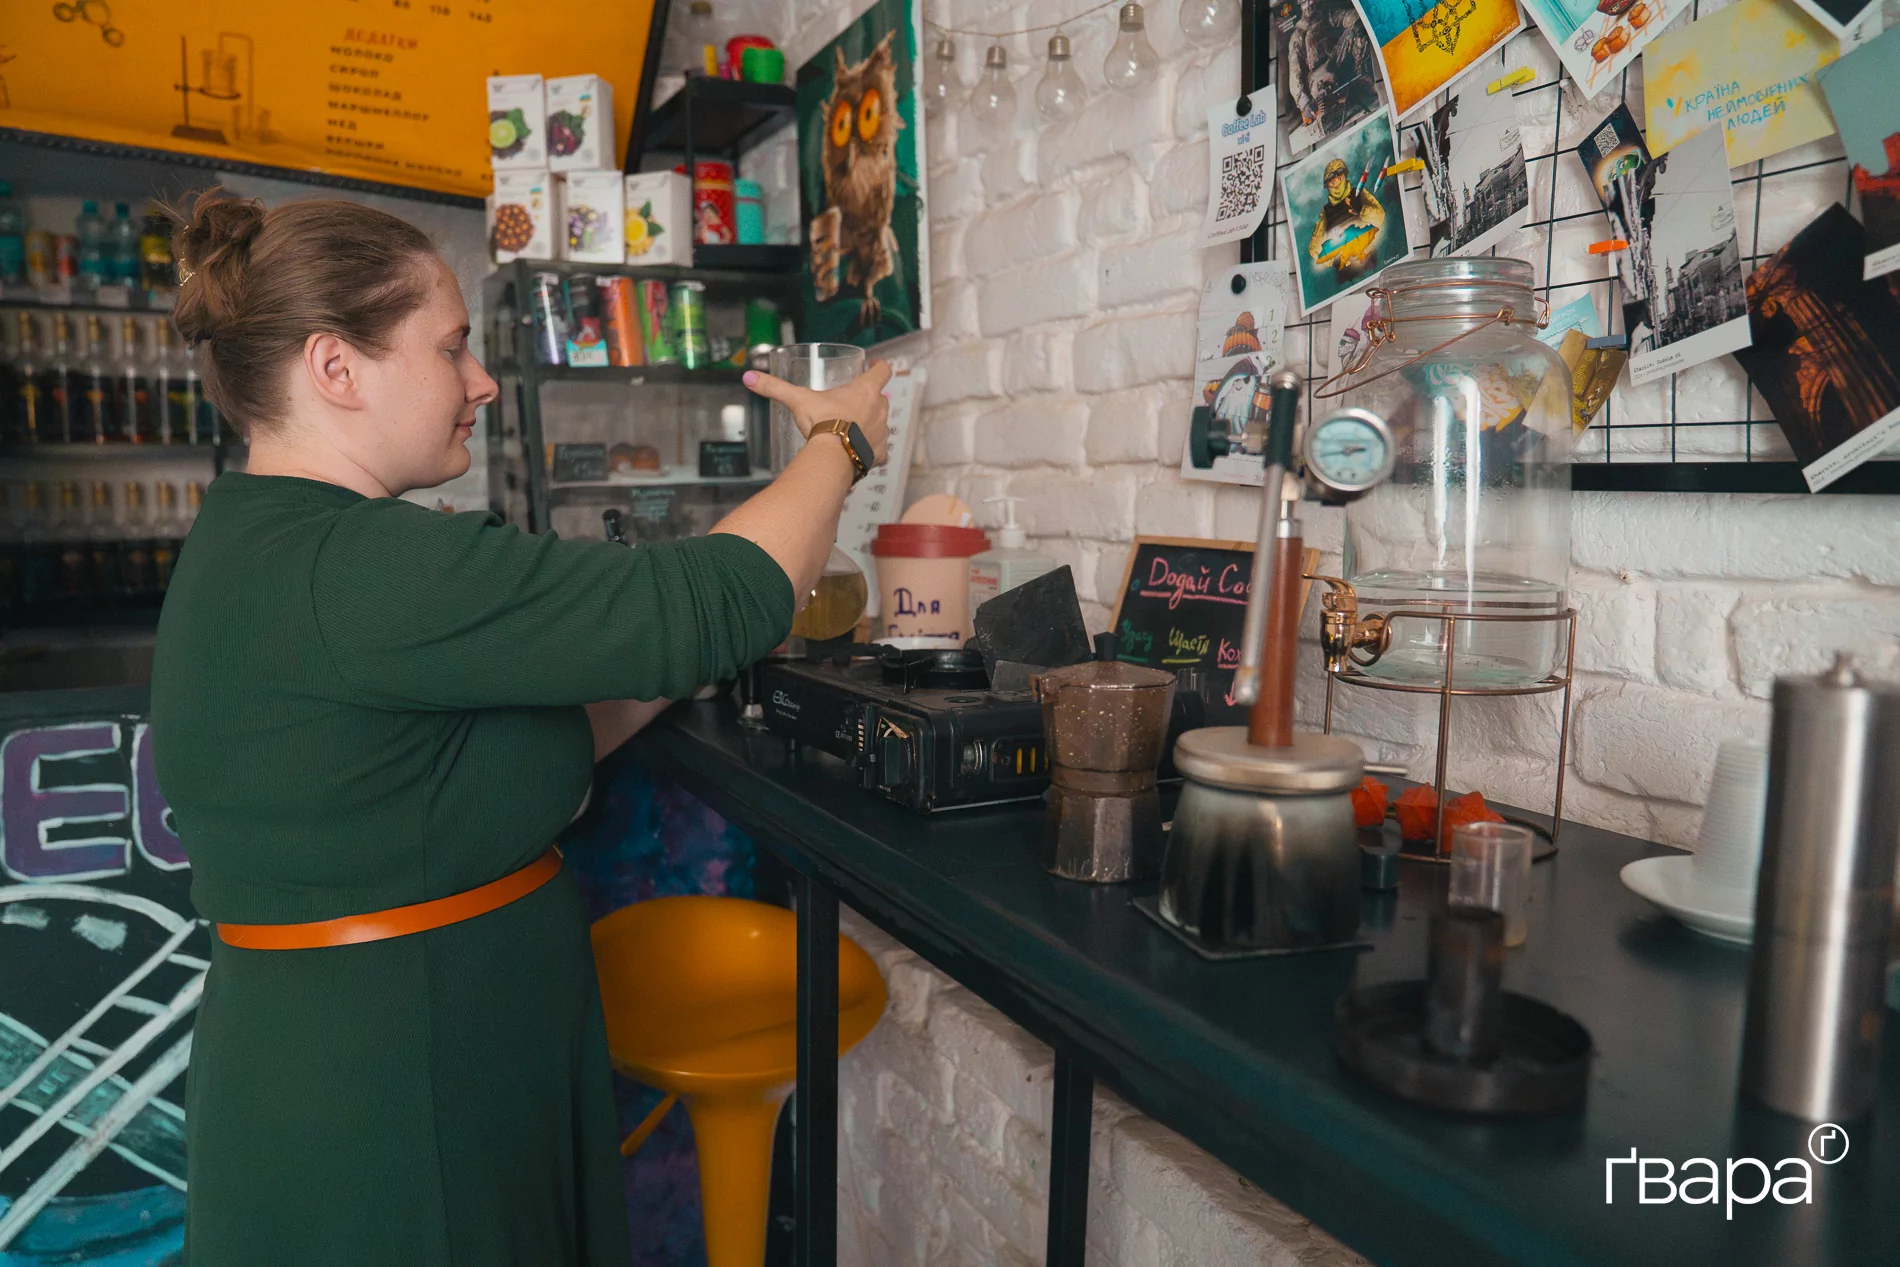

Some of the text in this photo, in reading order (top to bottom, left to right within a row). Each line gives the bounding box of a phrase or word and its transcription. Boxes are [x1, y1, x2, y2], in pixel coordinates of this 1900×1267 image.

[329, 45, 394, 63] МОЛОКО
[328, 64, 380, 79] СИРОП
[327, 82, 402, 101] ШОКОЛАД
[1685, 81, 1740, 112] КРАЇНА
[1250, 109, 1267, 129] Lab
[1727, 96, 1786, 130] ЛЮДЕЙ
[893, 588, 941, 617] Для
